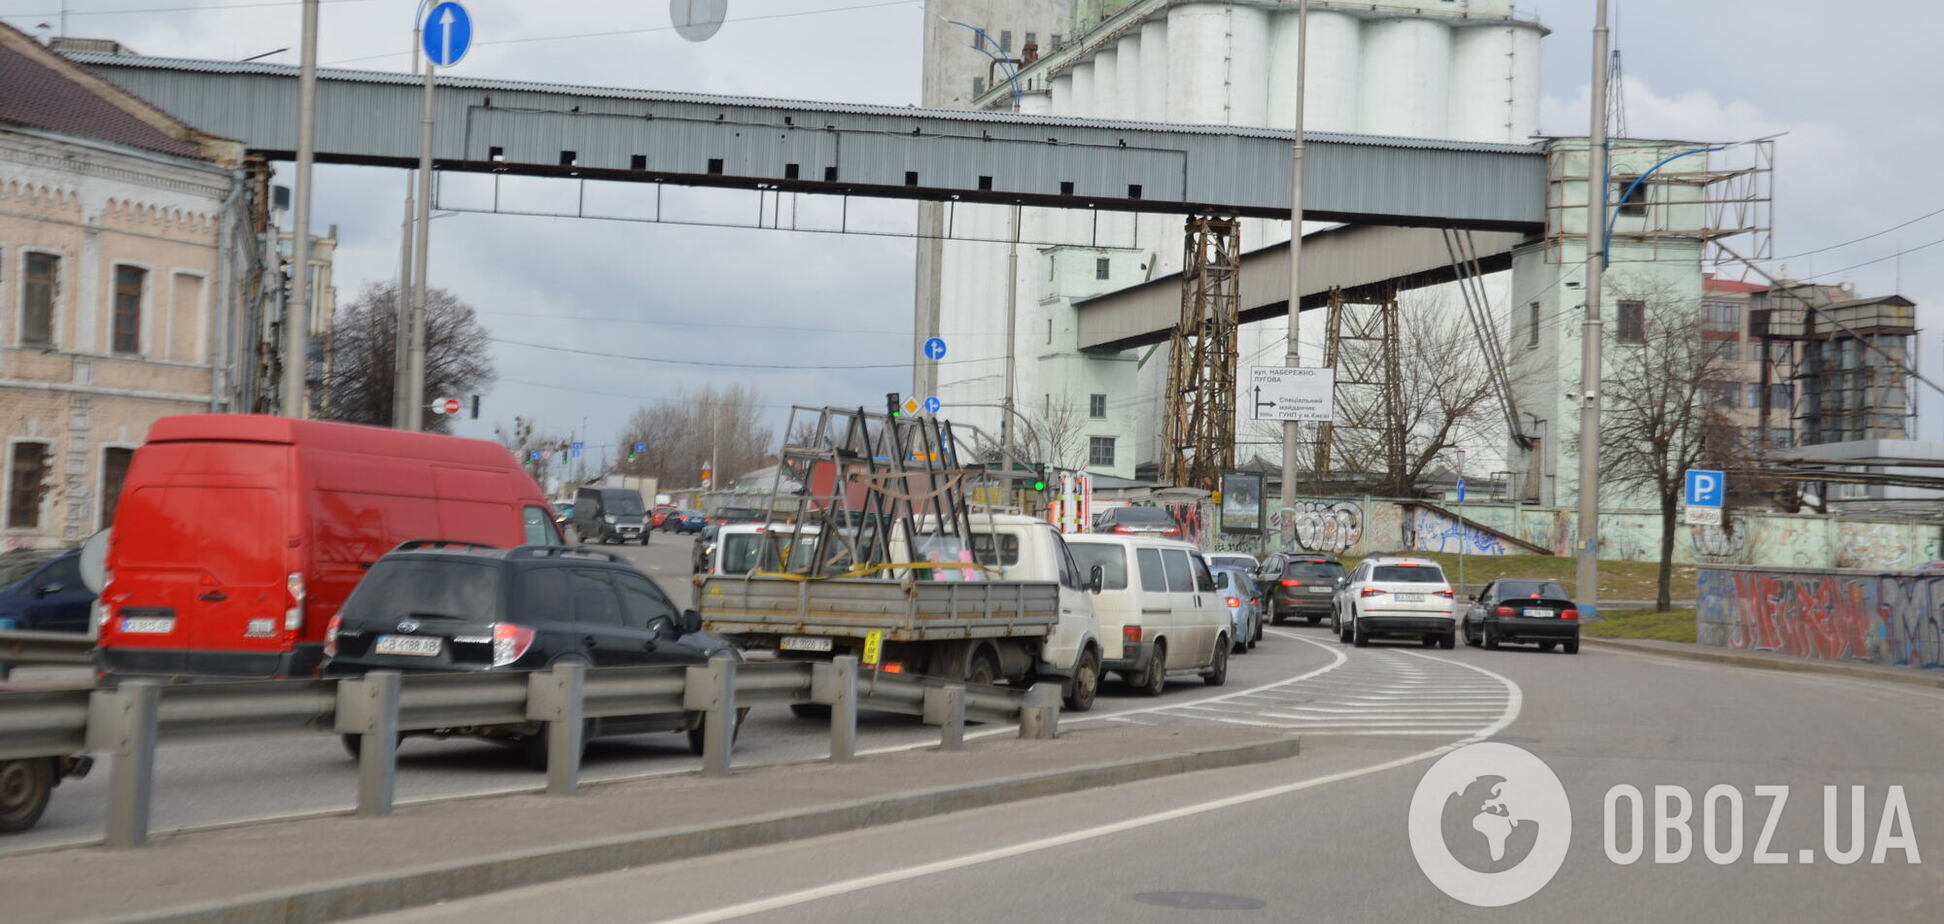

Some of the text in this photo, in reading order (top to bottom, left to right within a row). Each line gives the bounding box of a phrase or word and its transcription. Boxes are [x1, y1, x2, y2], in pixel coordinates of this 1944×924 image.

[1254, 369, 1316, 377] вул. НАБЕРЕЖНО-
[1279, 396, 1323, 404] Спеціальний
[1694, 475, 1715, 502] P
